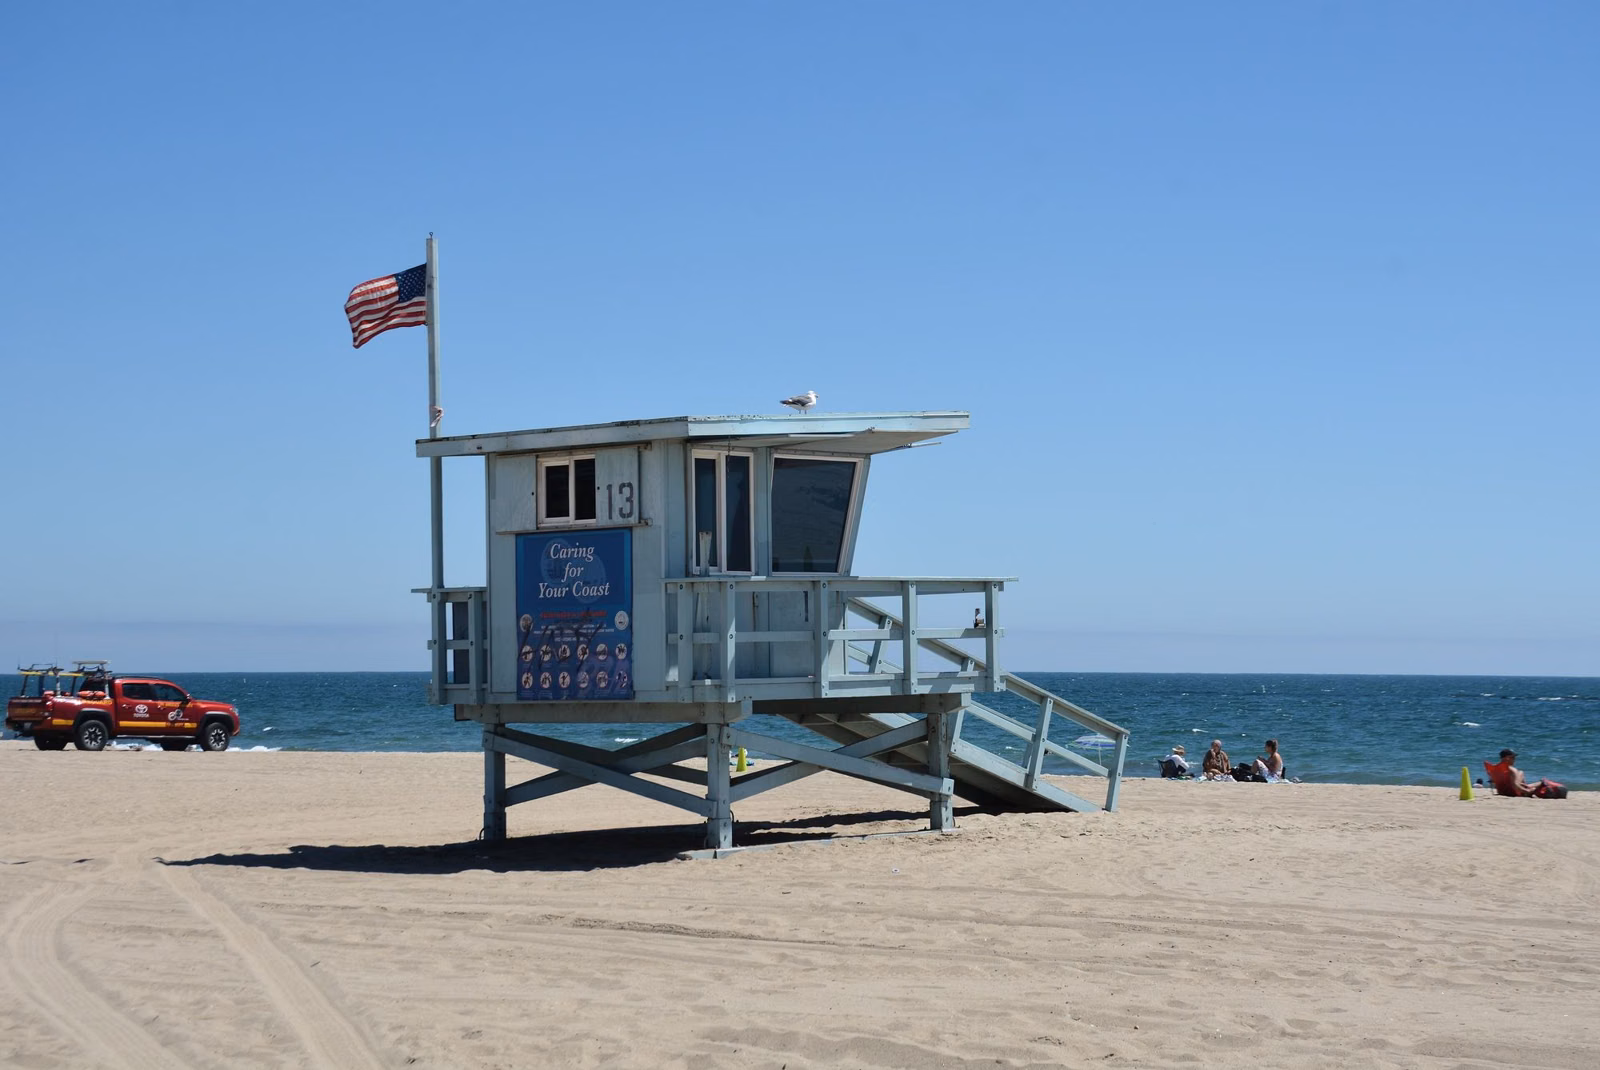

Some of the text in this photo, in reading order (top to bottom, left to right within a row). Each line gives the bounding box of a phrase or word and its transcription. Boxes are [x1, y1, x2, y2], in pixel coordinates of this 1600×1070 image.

[606, 481, 634, 520] 13
[550, 542, 595, 562] Caring
[561, 562, 584, 582] for
[539, 580, 610, 598] Your Coast
